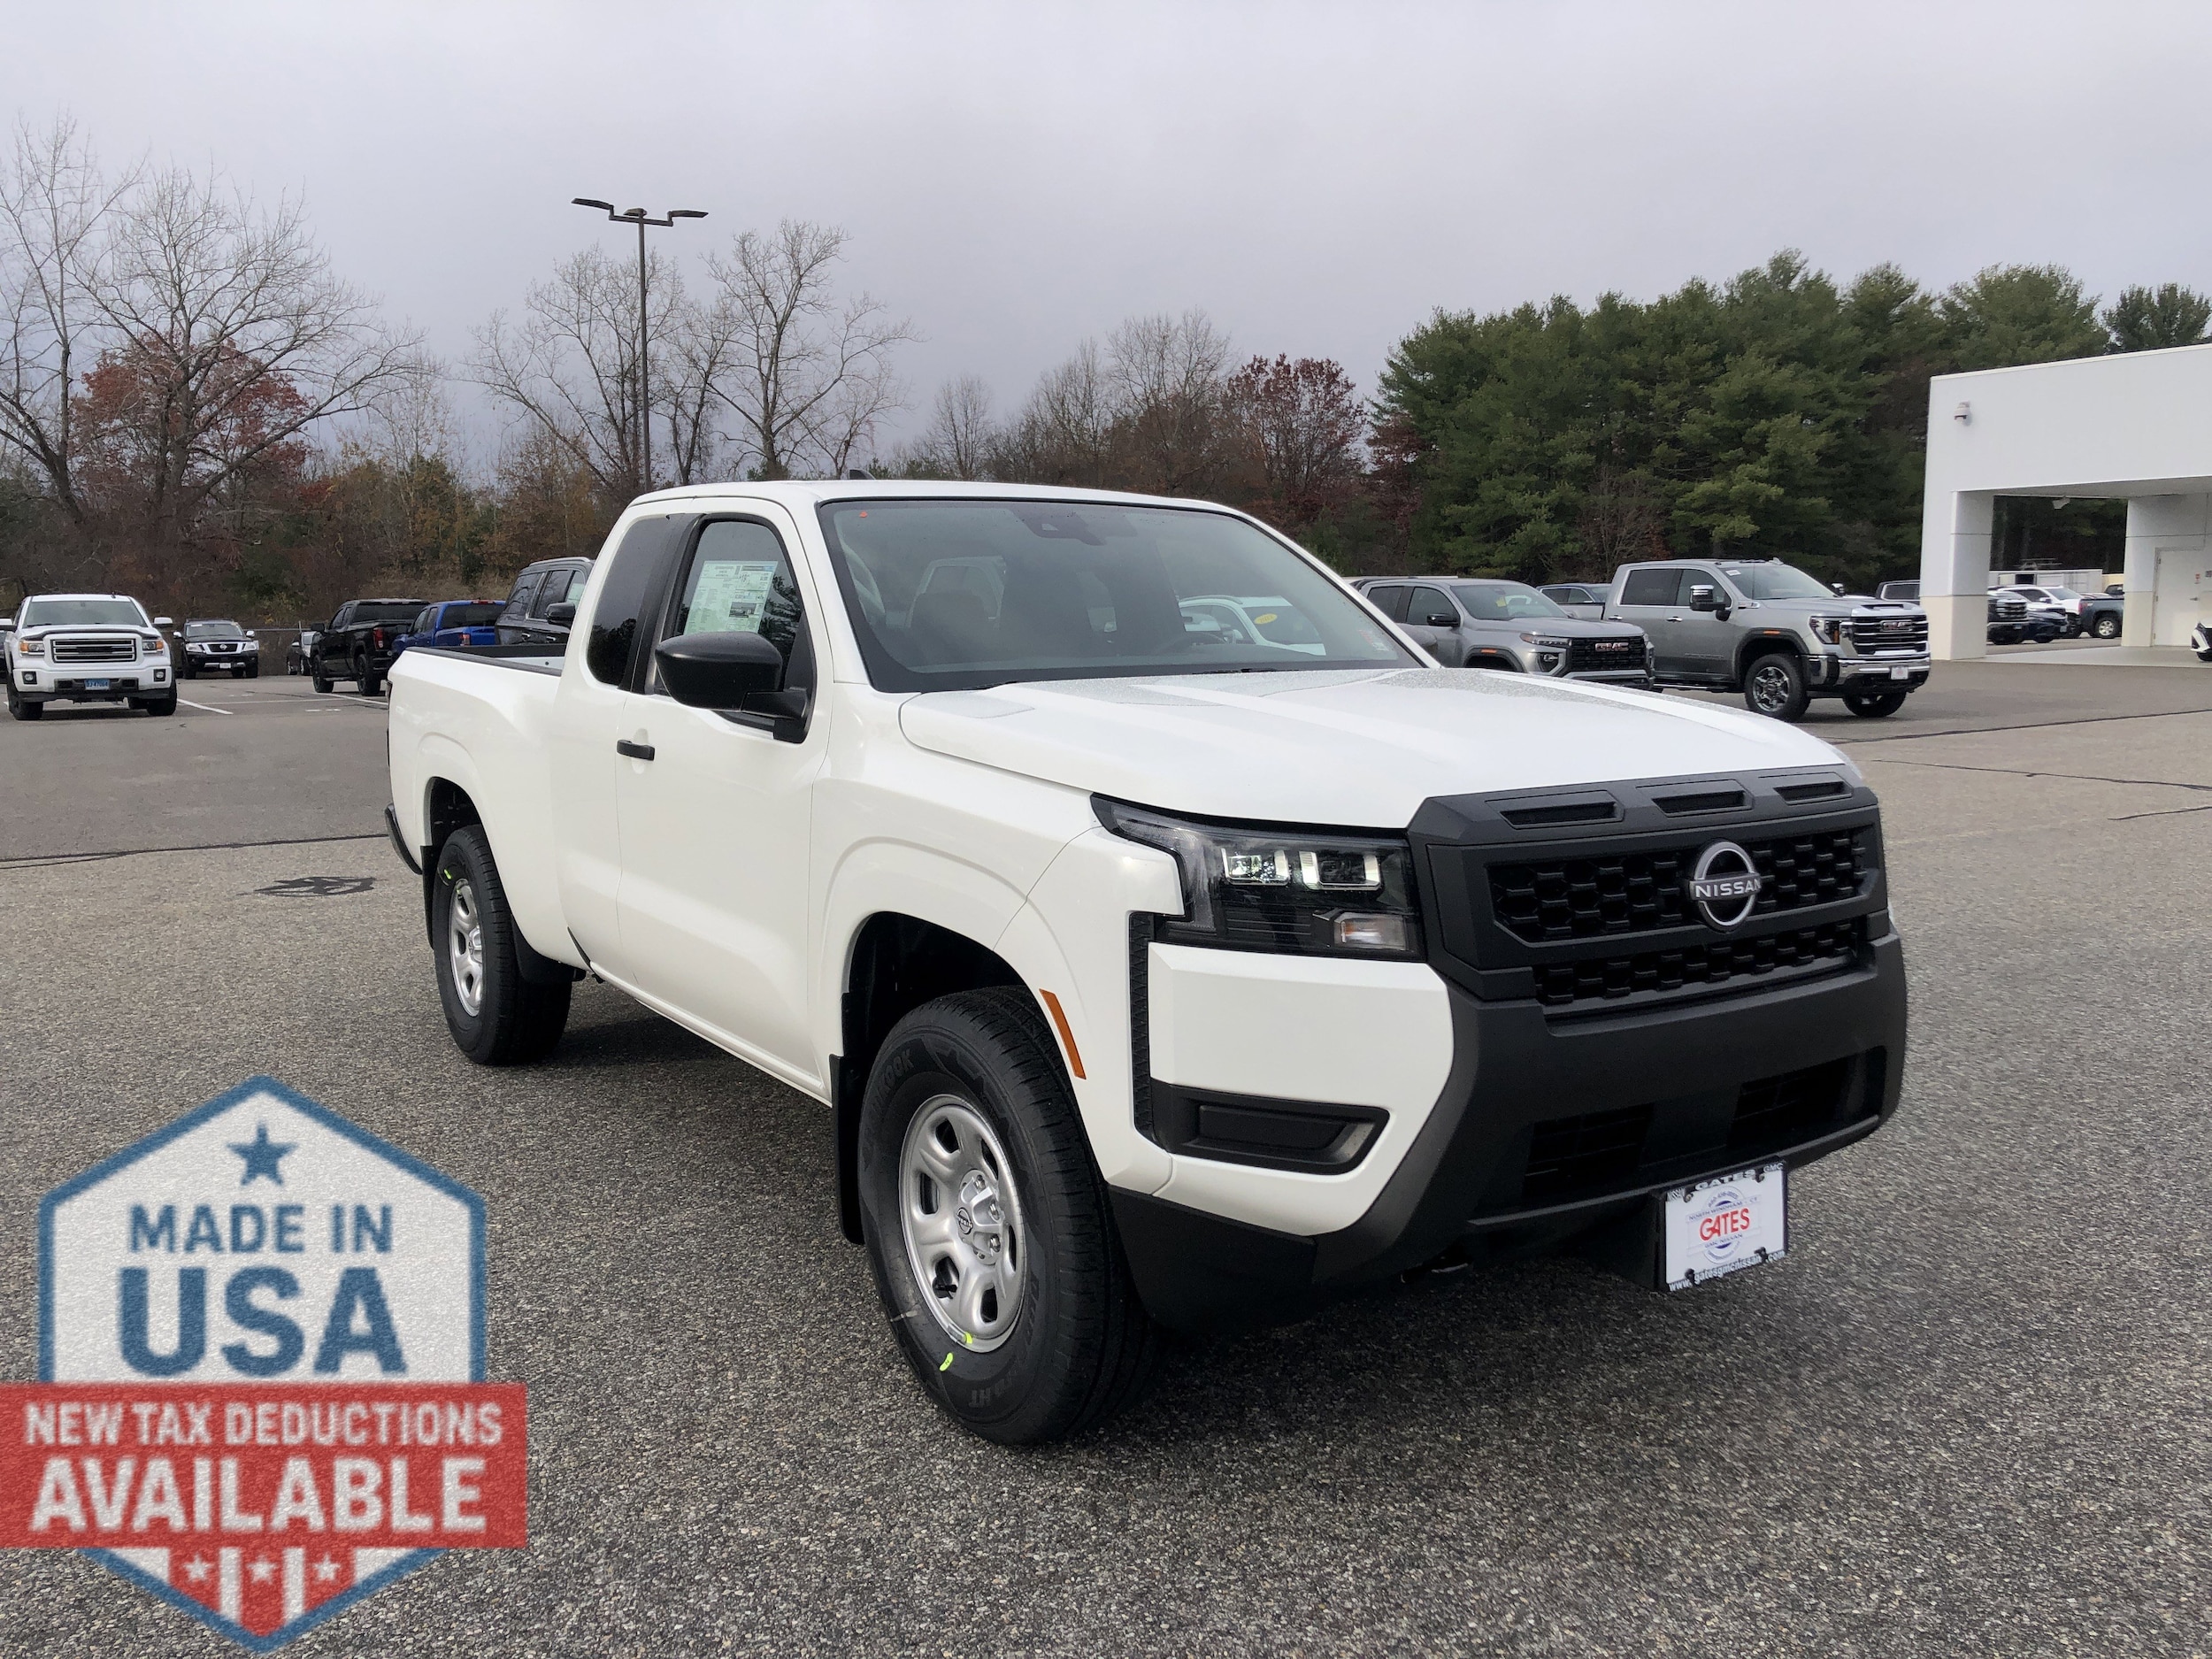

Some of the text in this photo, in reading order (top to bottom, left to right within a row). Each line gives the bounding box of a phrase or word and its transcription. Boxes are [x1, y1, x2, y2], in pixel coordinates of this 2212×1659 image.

[1595, 642, 1629, 651] GMC
[1695, 879, 1762, 898] NISSAN
[1694, 1162, 1784, 1191] GATES GMC
[1699, 1208, 1750, 1241] GATES
